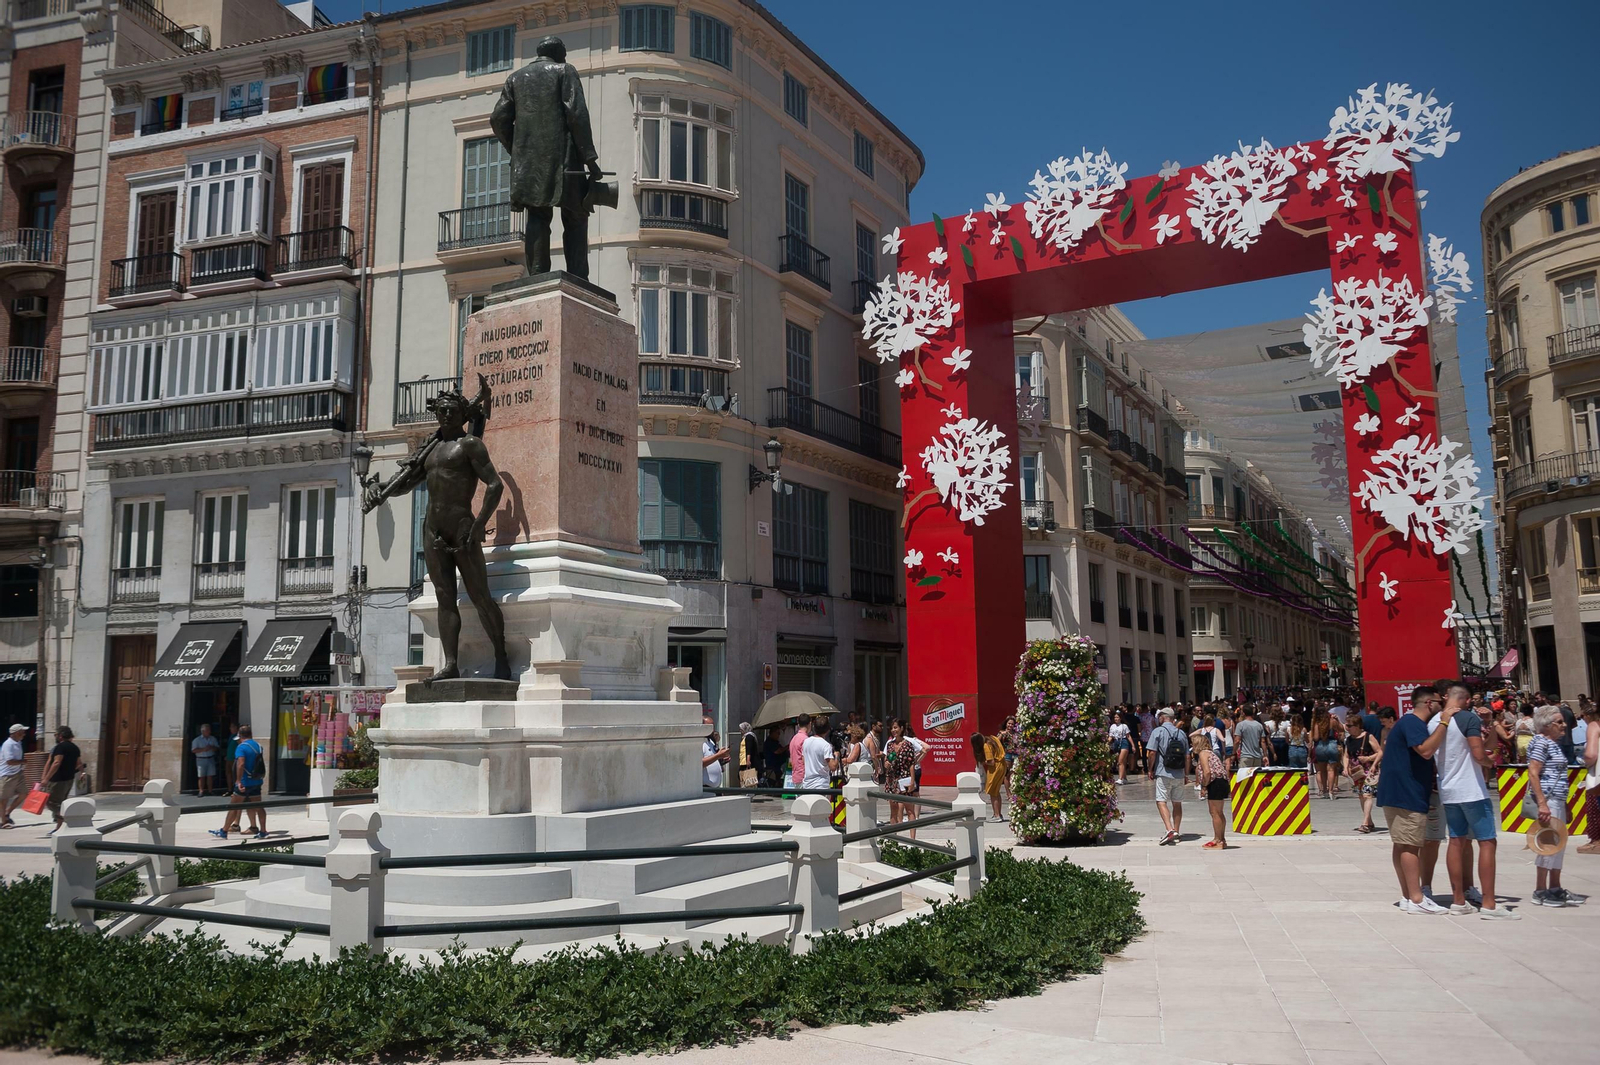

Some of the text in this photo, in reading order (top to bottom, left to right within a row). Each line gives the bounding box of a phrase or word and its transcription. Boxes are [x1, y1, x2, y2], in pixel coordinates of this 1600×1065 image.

[481, 320, 543, 344] INAUGURACION
[479, 350, 503, 366] ENERO
[604, 373, 629, 392] MALAGA
[514, 389, 533, 404] 1951
[588, 425, 625, 447] DICIEMBRE
[184, 648, 204, 657] 24H
[274, 644, 293, 652] 24H
[335, 654, 352, 665] 24H
[154, 668, 205, 677] FARMACIA
[243, 664, 297, 673] FARMACIA
